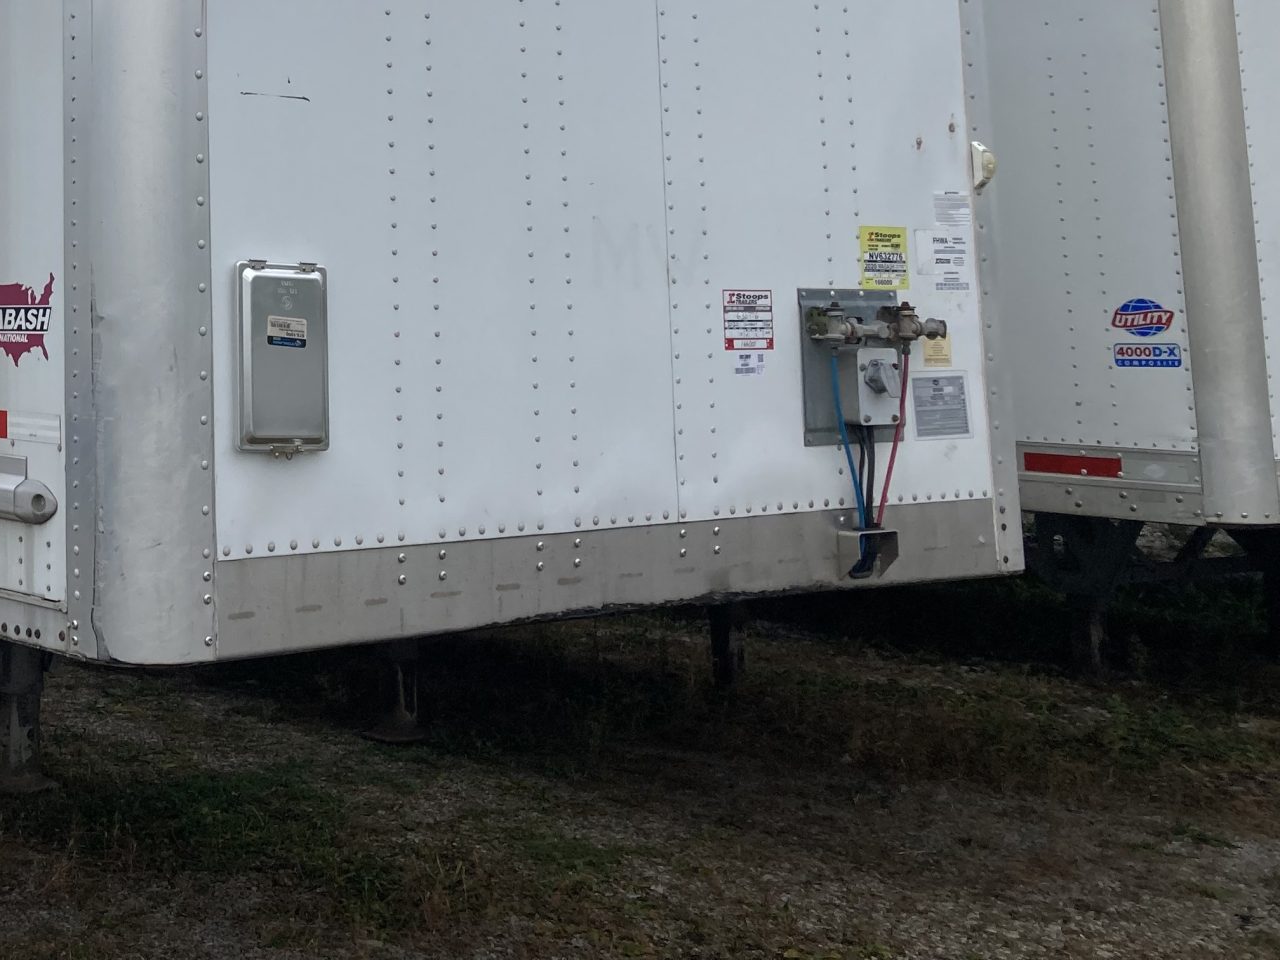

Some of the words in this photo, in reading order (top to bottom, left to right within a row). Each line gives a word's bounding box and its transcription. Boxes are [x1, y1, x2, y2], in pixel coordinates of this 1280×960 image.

[874, 231, 901, 239] Stoops
[736, 293, 769, 301] Stoops
[1115, 312, 1171, 326] UTILITY
[0, 334, 28, 343] NATIONAL
[1116, 346, 1178, 358] 4000D-X
